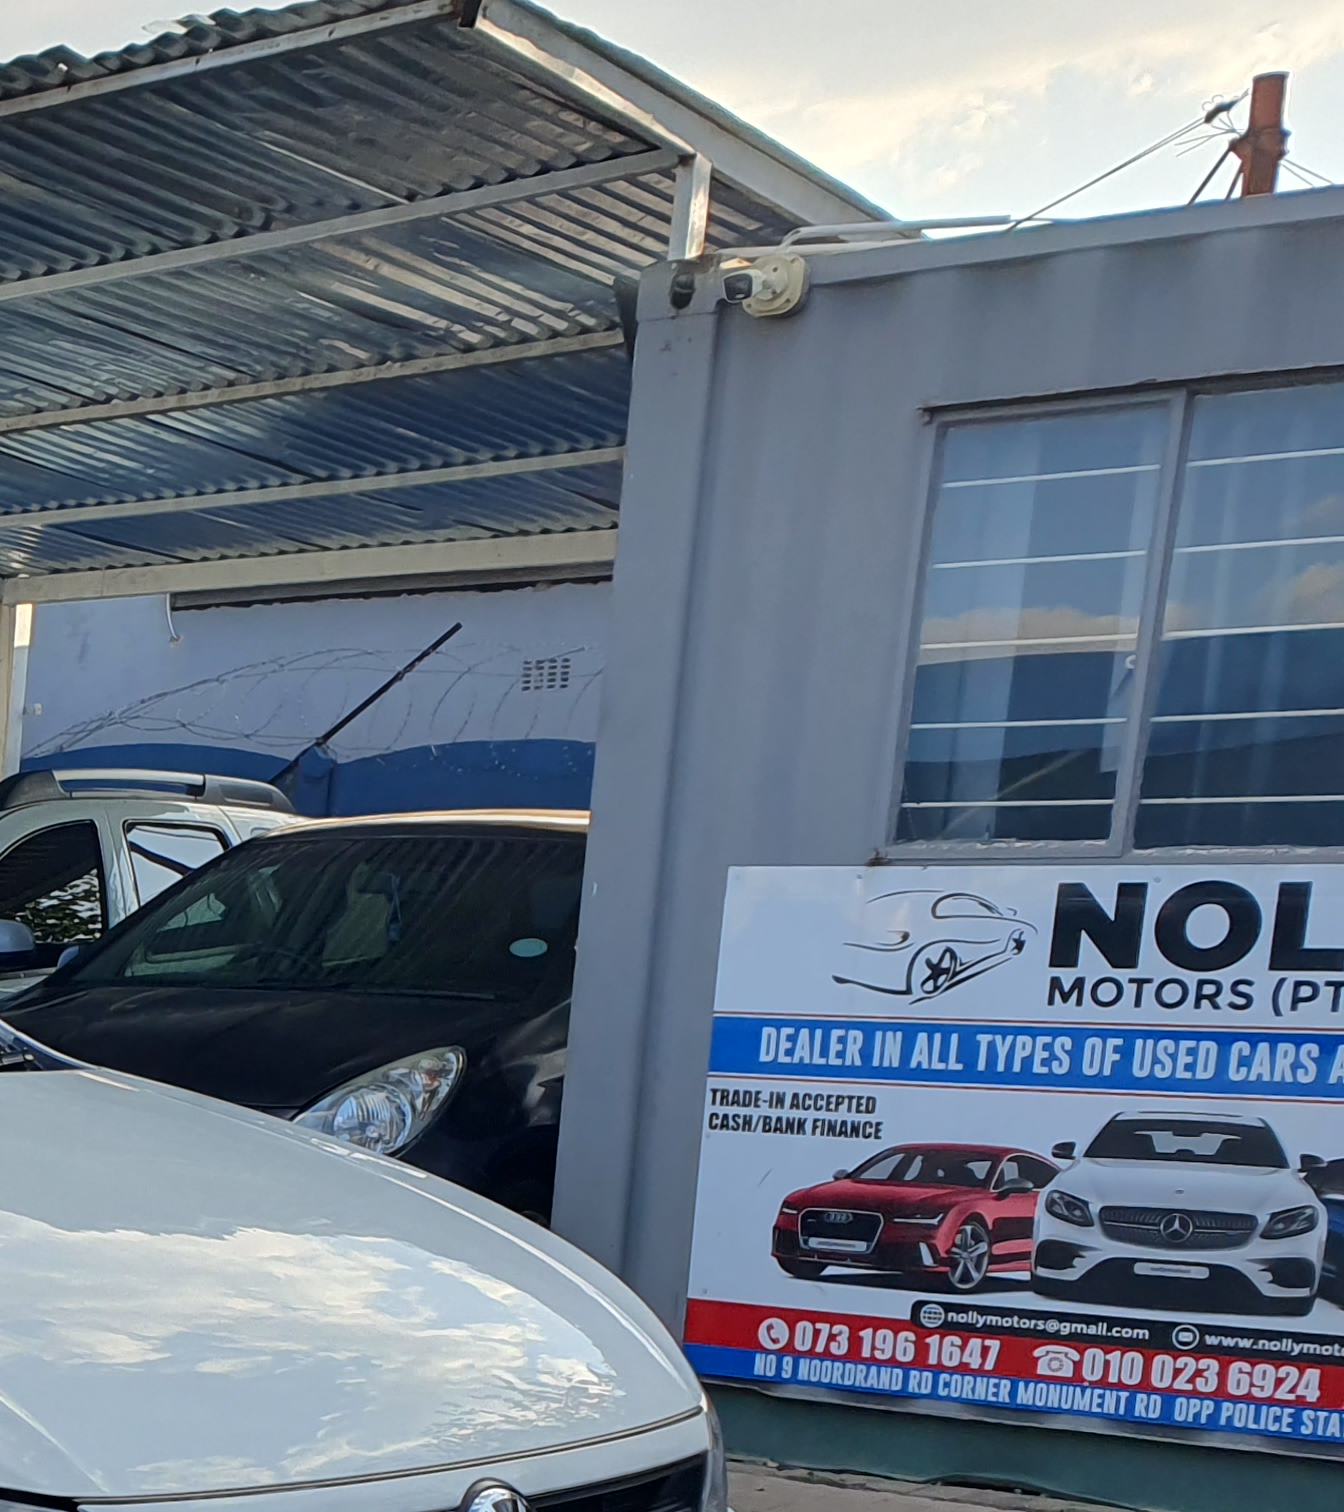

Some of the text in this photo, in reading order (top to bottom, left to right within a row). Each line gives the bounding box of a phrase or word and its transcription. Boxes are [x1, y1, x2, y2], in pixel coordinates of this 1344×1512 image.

[1047, 976, 1255, 1011] MOTORS
[759, 1027, 863, 1067] DEALER
[872, 1030, 903, 1067] IN
[910, 1032, 964, 1070] ALL
[976, 1034, 1072, 1074] TYPES
[1082, 1037, 1124, 1076] OF
[1132, 1038, 1219, 1079] USED
[1228, 1041, 1320, 1084] CARS
[709, 1088, 877, 1115] TRADE-IN ACCEPTED
[708, 1112, 884, 1140] CASH/BANK FINANCE
[794, 1320, 1001, 1371] 073 196 1647
[947, 1309, 1149, 1340] nollymotors@gmail.com
[754, 1353, 777, 1377] NO
[781, 1356, 793, 1379] 9
[797, 1358, 902, 1391] NOORDRAND
[911, 1370, 933, 1394] RD
[938, 1373, 1011, 1403] CORNER
[1017, 1380, 1129, 1416] MONUMENT
[1134, 1393, 1162, 1419] RD
[1173, 1397, 1214, 1425] OPP
[1219, 1401, 1296, 1433] POLICE
[1081, 1347, 1321, 1403] 010 023 6924
